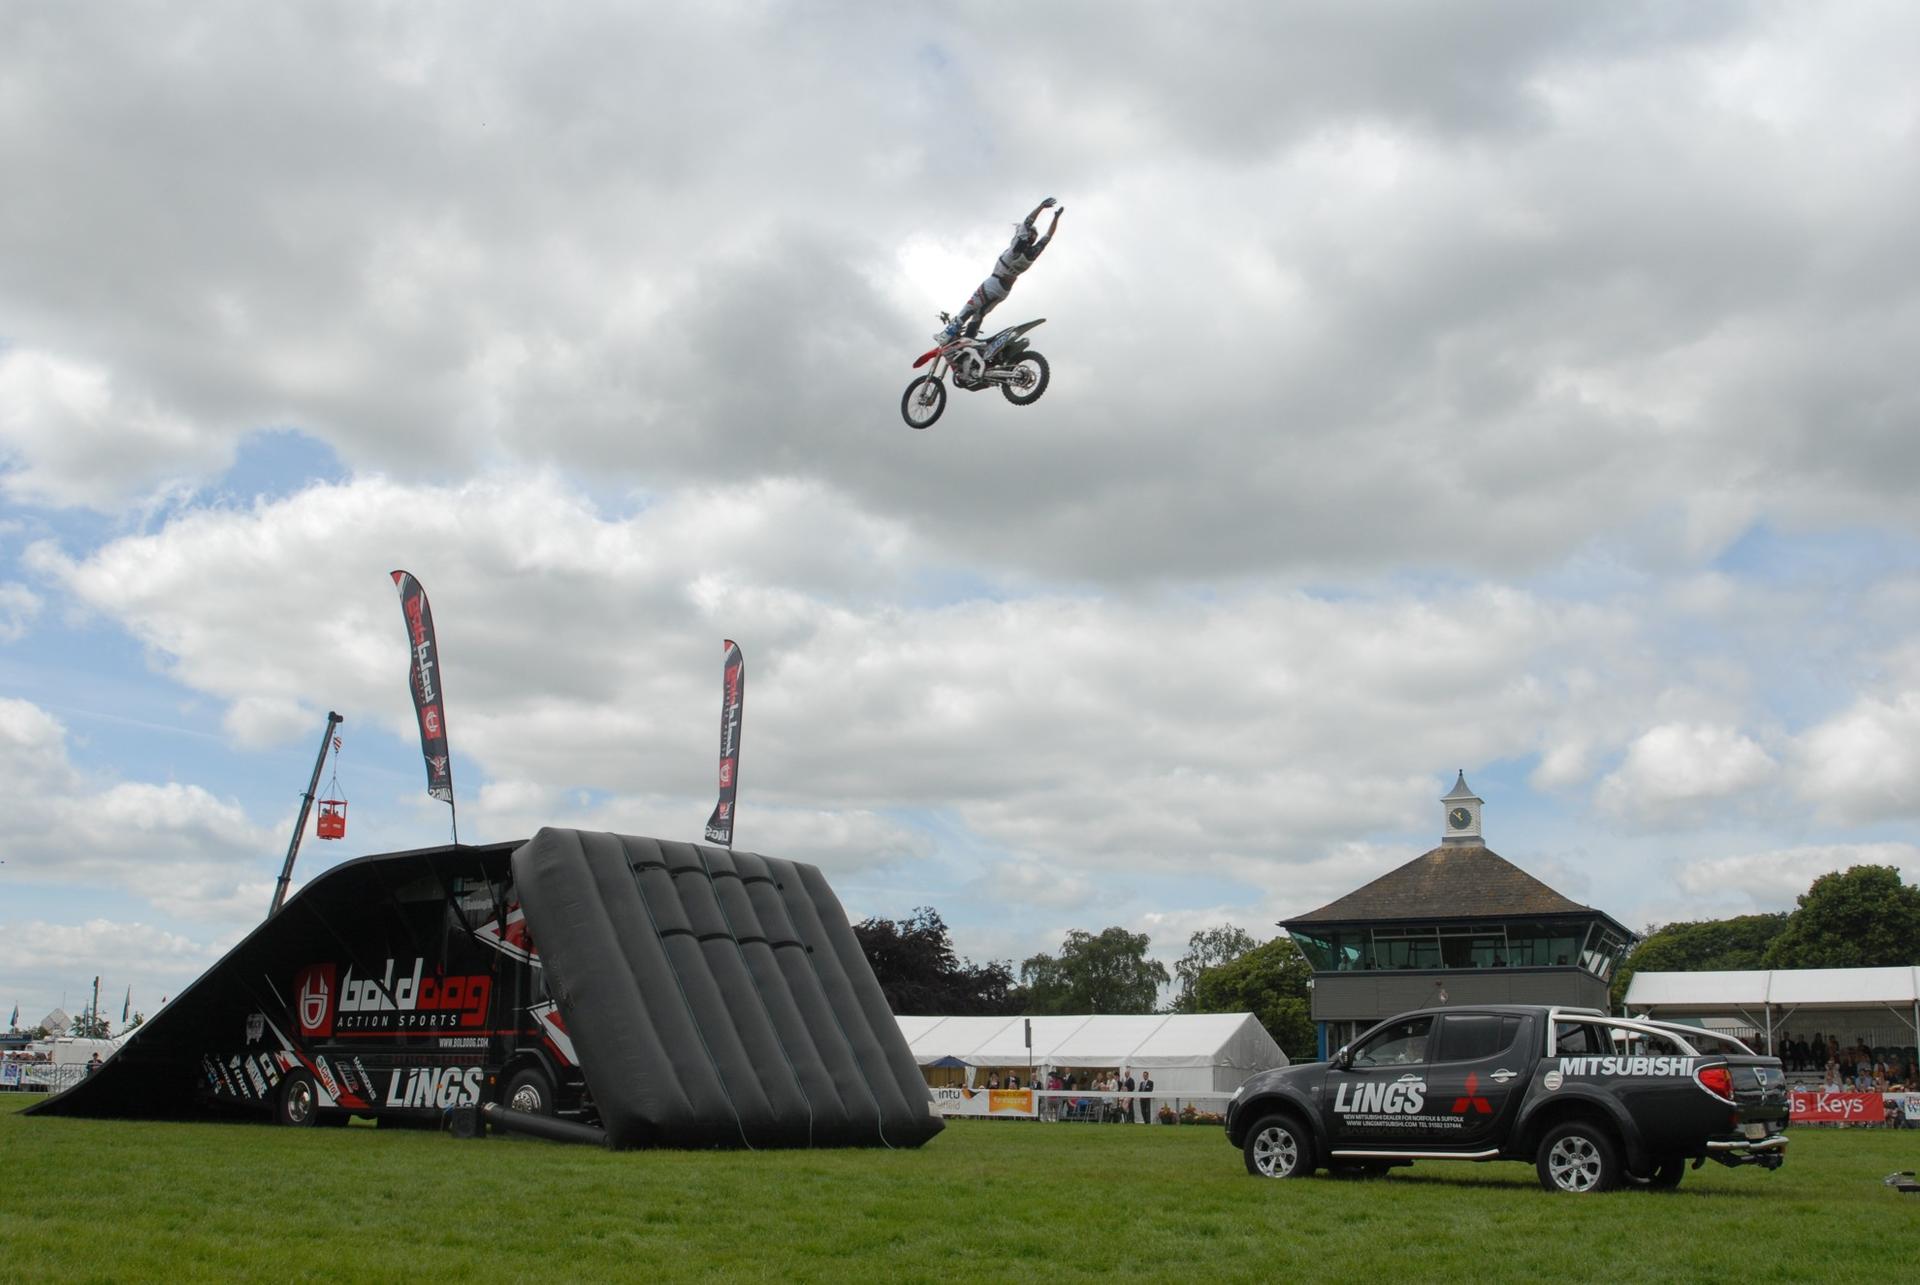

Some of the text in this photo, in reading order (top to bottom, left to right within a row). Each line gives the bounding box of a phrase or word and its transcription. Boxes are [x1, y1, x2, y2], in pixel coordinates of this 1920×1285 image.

[337, 1014, 458, 1028] ACTION SPORTS
[1559, 1057, 1695, 1077] MITSUBISHI
[320, 1065, 340, 1098] Castrol
[938, 1089, 960, 1100] intu
[1816, 1092, 1864, 1119] Keys
